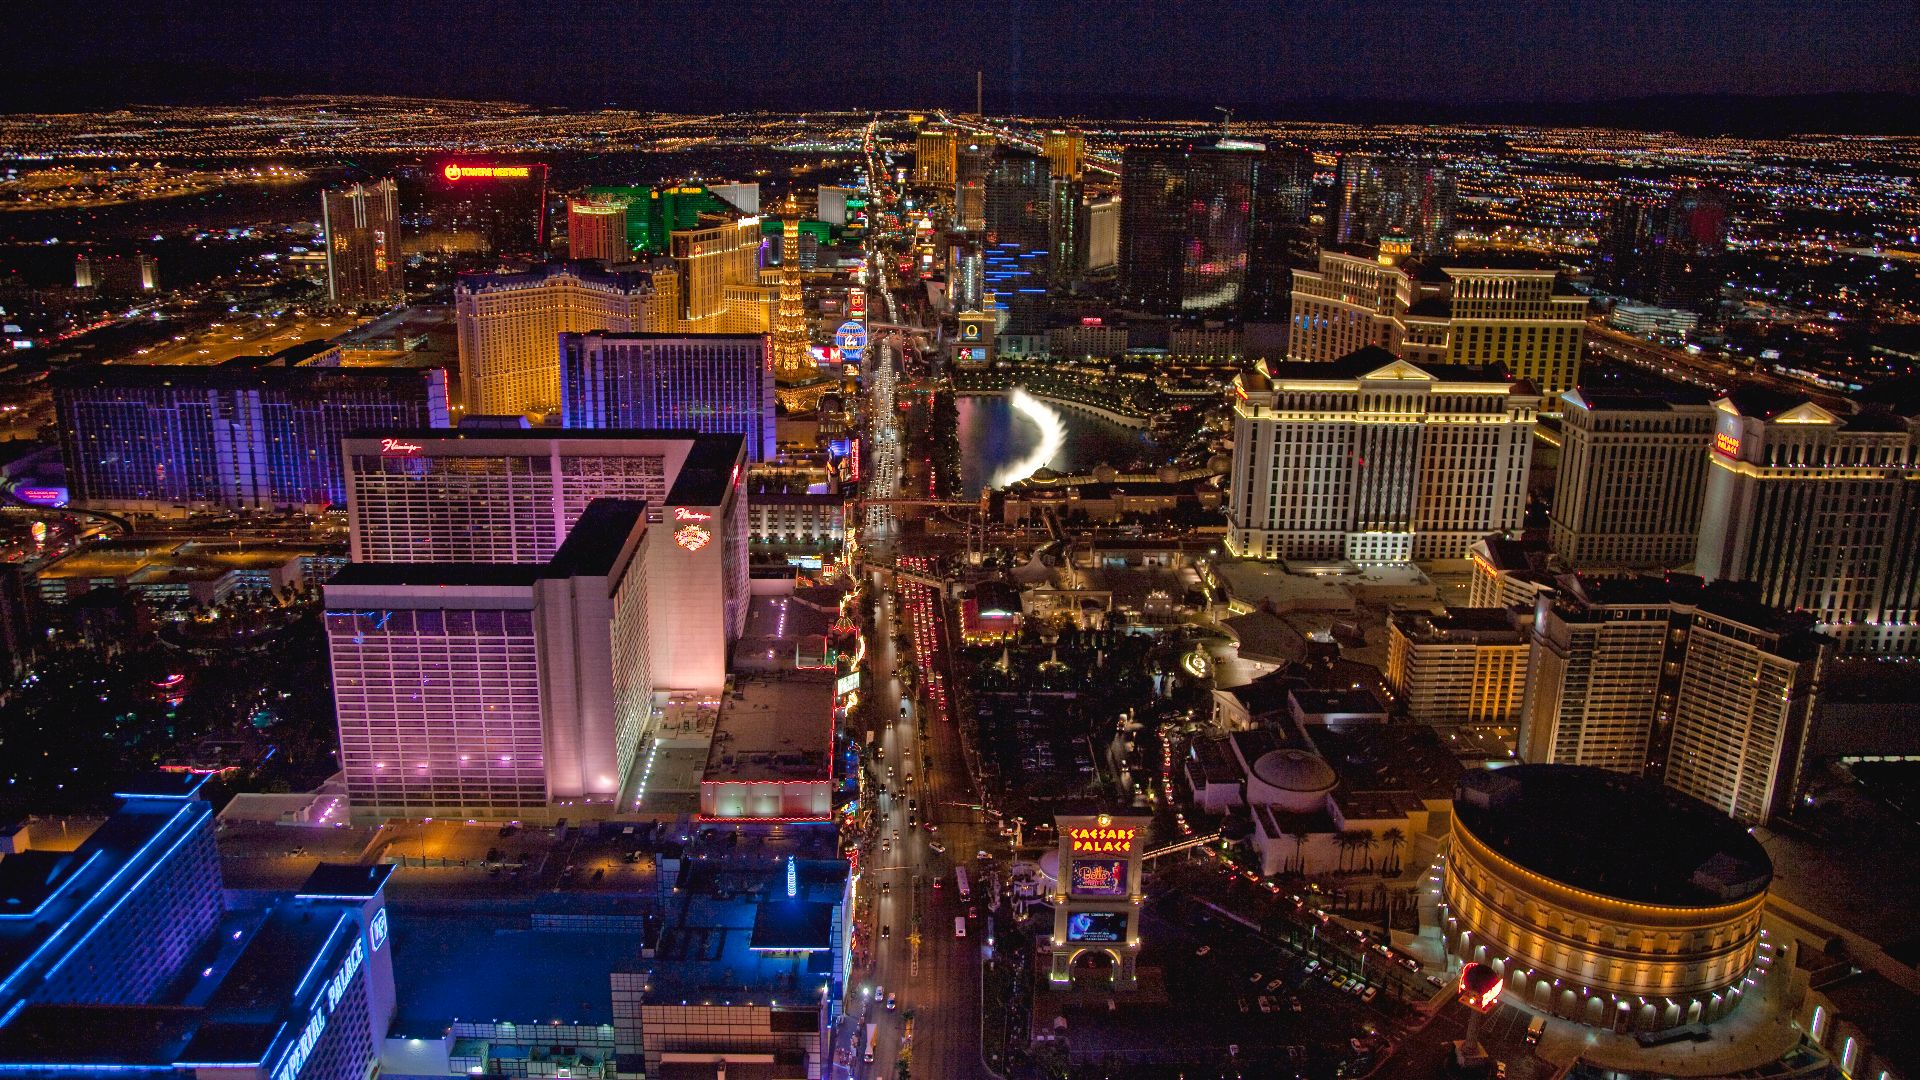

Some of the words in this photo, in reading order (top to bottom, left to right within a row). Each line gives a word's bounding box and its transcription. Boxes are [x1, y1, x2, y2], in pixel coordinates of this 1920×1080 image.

[461, 168, 492, 177] TOWERS
[493, 168, 529, 177] WESTGATE
[381, 438, 422, 454] Flamingo
[1717, 440, 1738, 455] PALACE
[674, 507, 711, 522] Flamingo
[1070, 828, 1135, 840] CAESARS
[1073, 841, 1131, 852] PALACE
[327, 937, 364, 1013] PALACE
